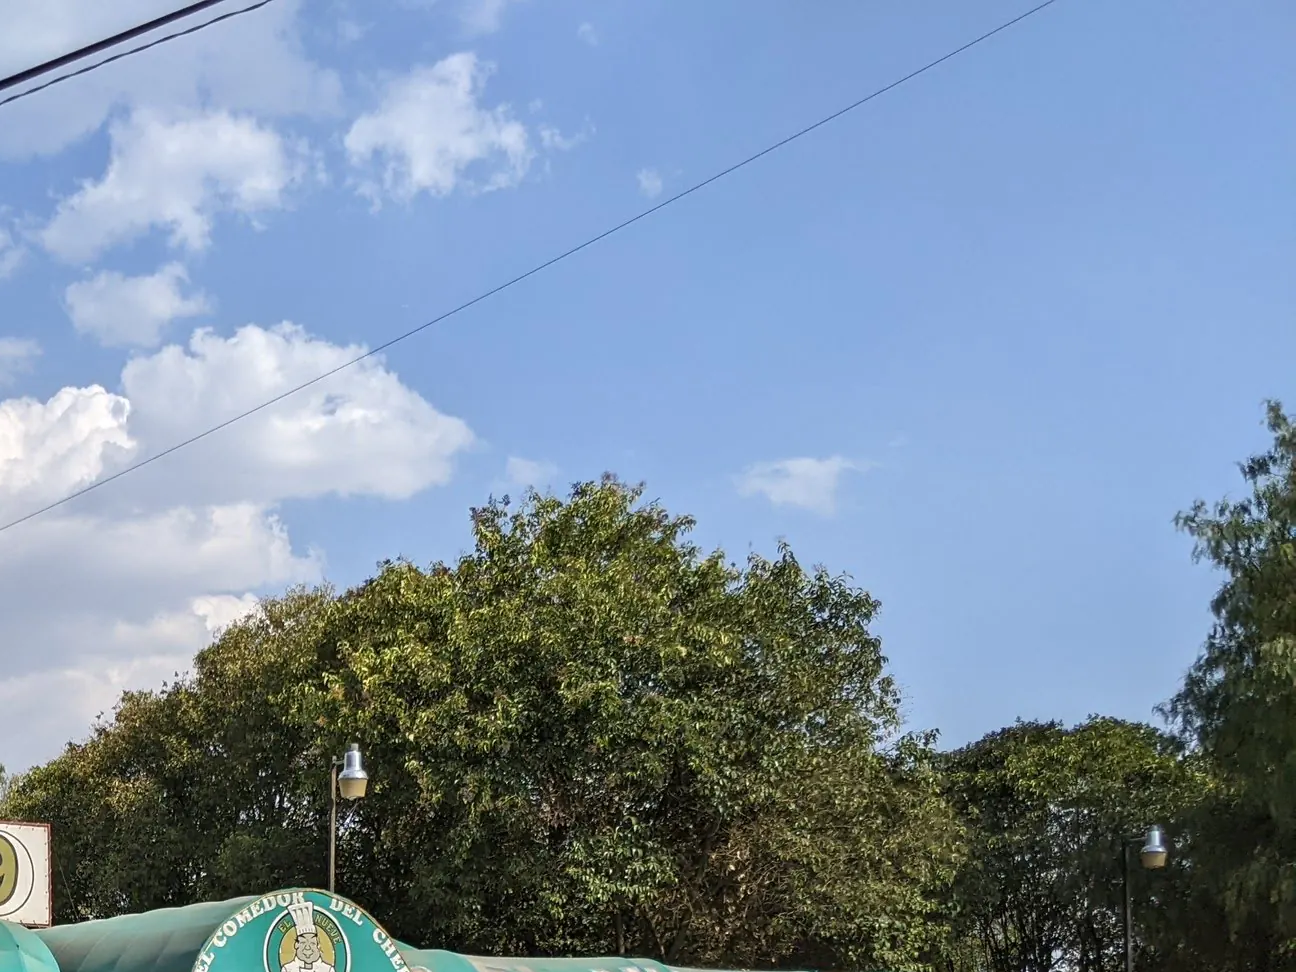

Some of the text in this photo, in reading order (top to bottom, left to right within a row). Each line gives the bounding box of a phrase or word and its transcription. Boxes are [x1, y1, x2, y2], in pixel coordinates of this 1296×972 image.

[211, 891, 304, 948] COMEDOR
[328, 898, 363, 926] DEL
[278, 914, 341, 945] EL NUEVE
